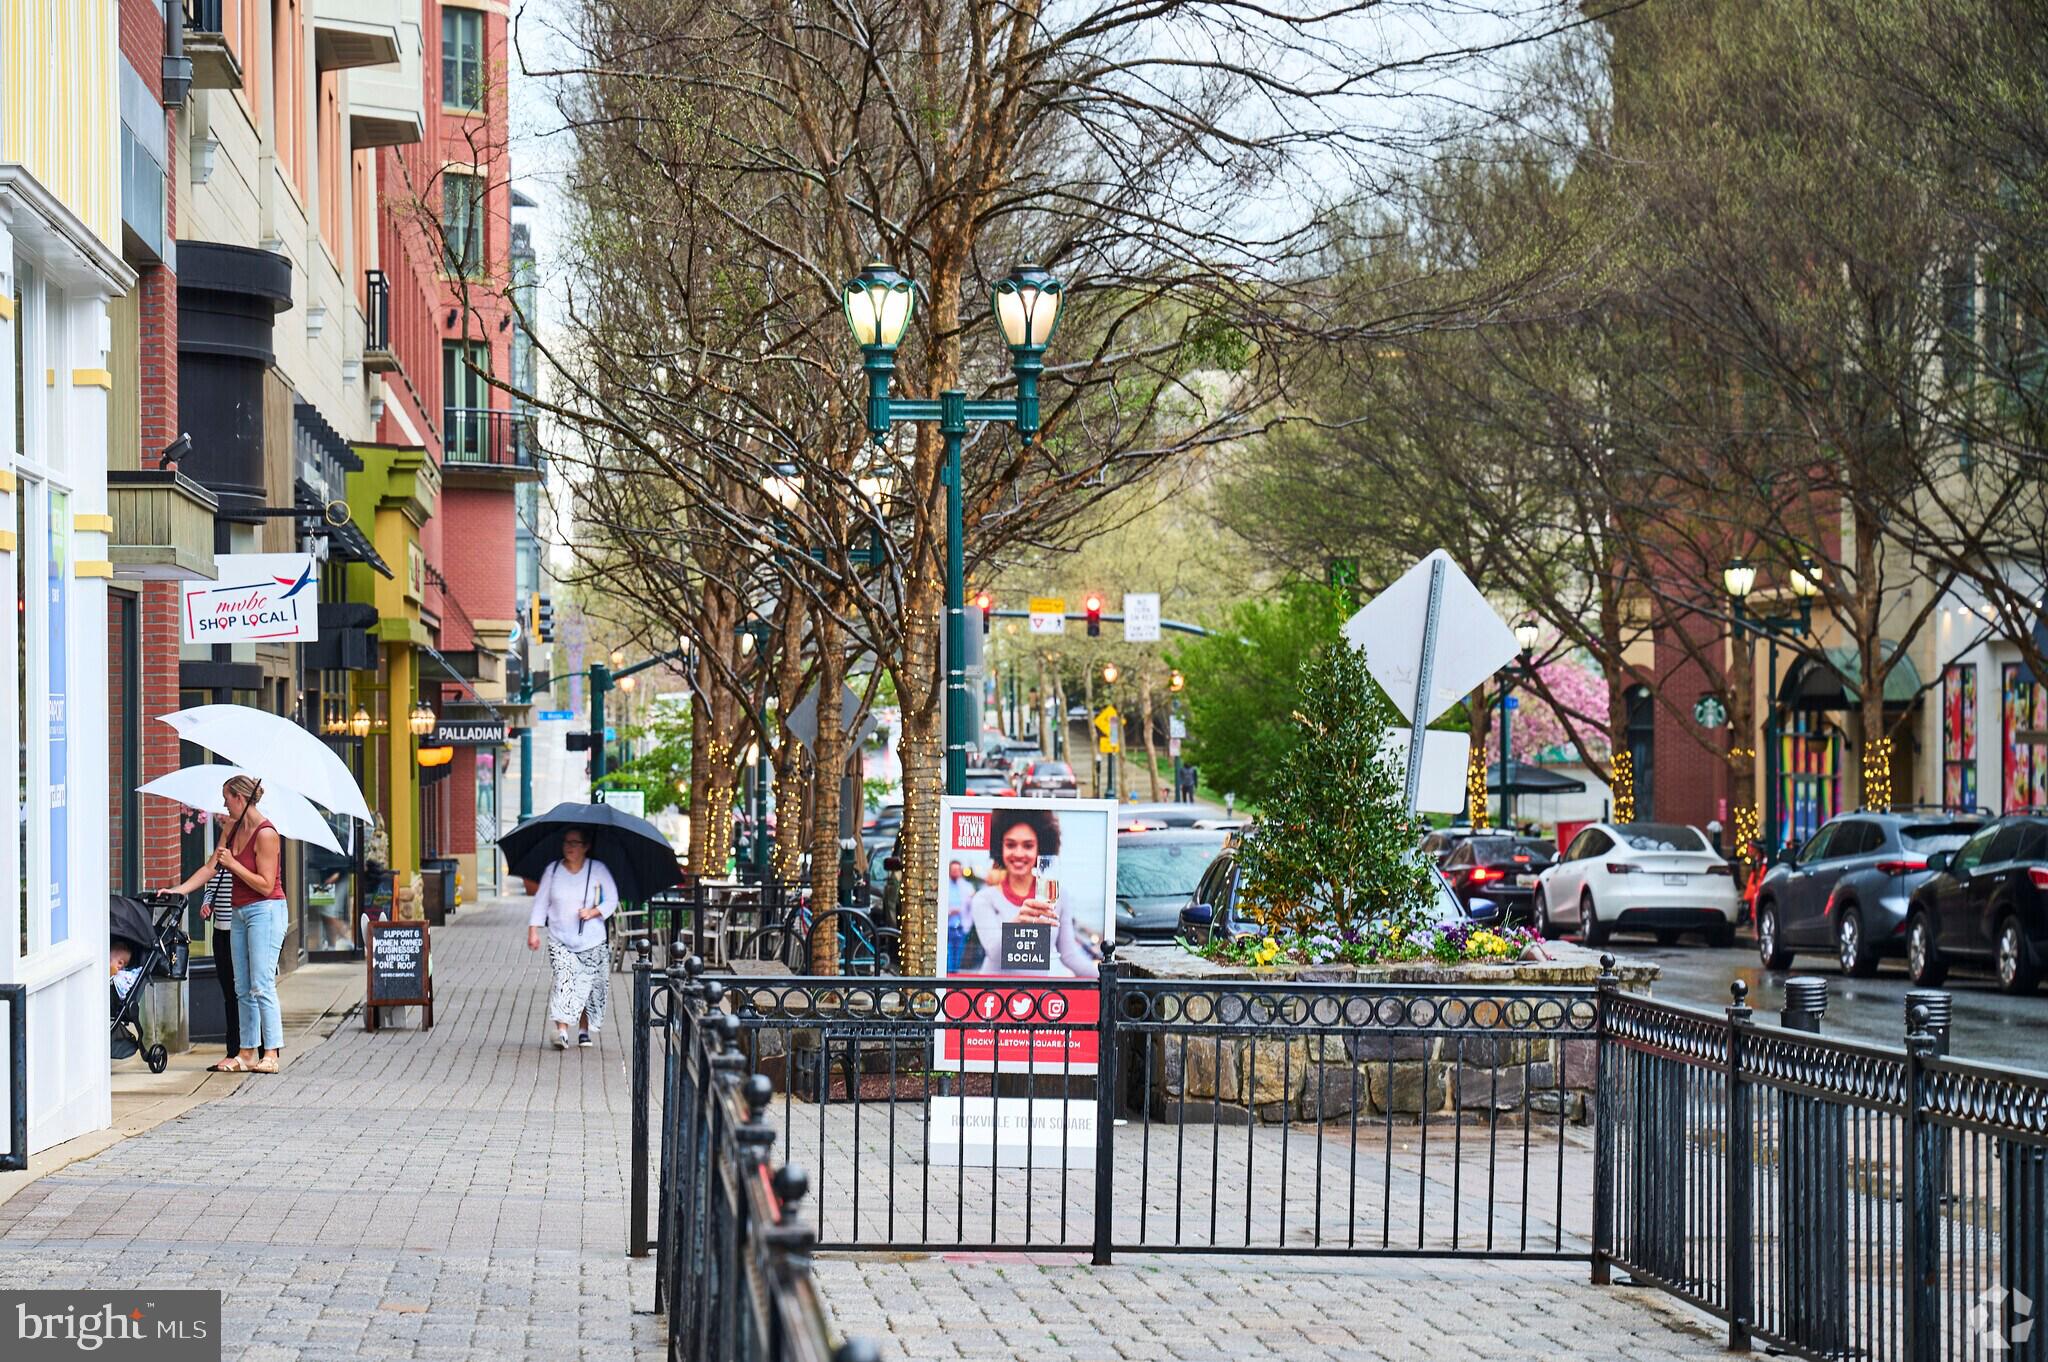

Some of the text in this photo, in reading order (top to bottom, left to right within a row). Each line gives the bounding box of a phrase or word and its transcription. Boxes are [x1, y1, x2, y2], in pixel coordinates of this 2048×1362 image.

[216, 591, 268, 613] mwbc
[199, 611, 289, 630] SHOP LOCAL
[439, 727, 502, 740] PALLADIAN
[958, 815, 985, 824] ROCKVILLE
[959, 823, 985, 836] TOWN
[958, 836, 985, 848] SQUARE
[384, 930, 414, 938] SUPPORT
[1014, 928, 1039, 938] LET'S
[375, 939, 423, 947] WOMEN OWNED
[1016, 941, 1036, 950] GET
[377, 946, 420, 954] BUSINESSES
[386, 954, 410, 962] UNDER
[1007, 953, 1044, 963] SOCIAL
[378, 961, 416, 970] ONE ROOF
[967, 1038, 1081, 1048] ROCKVLETOWNSQUARE.OM
[951, 1114, 1010, 1128] RCKVILE
